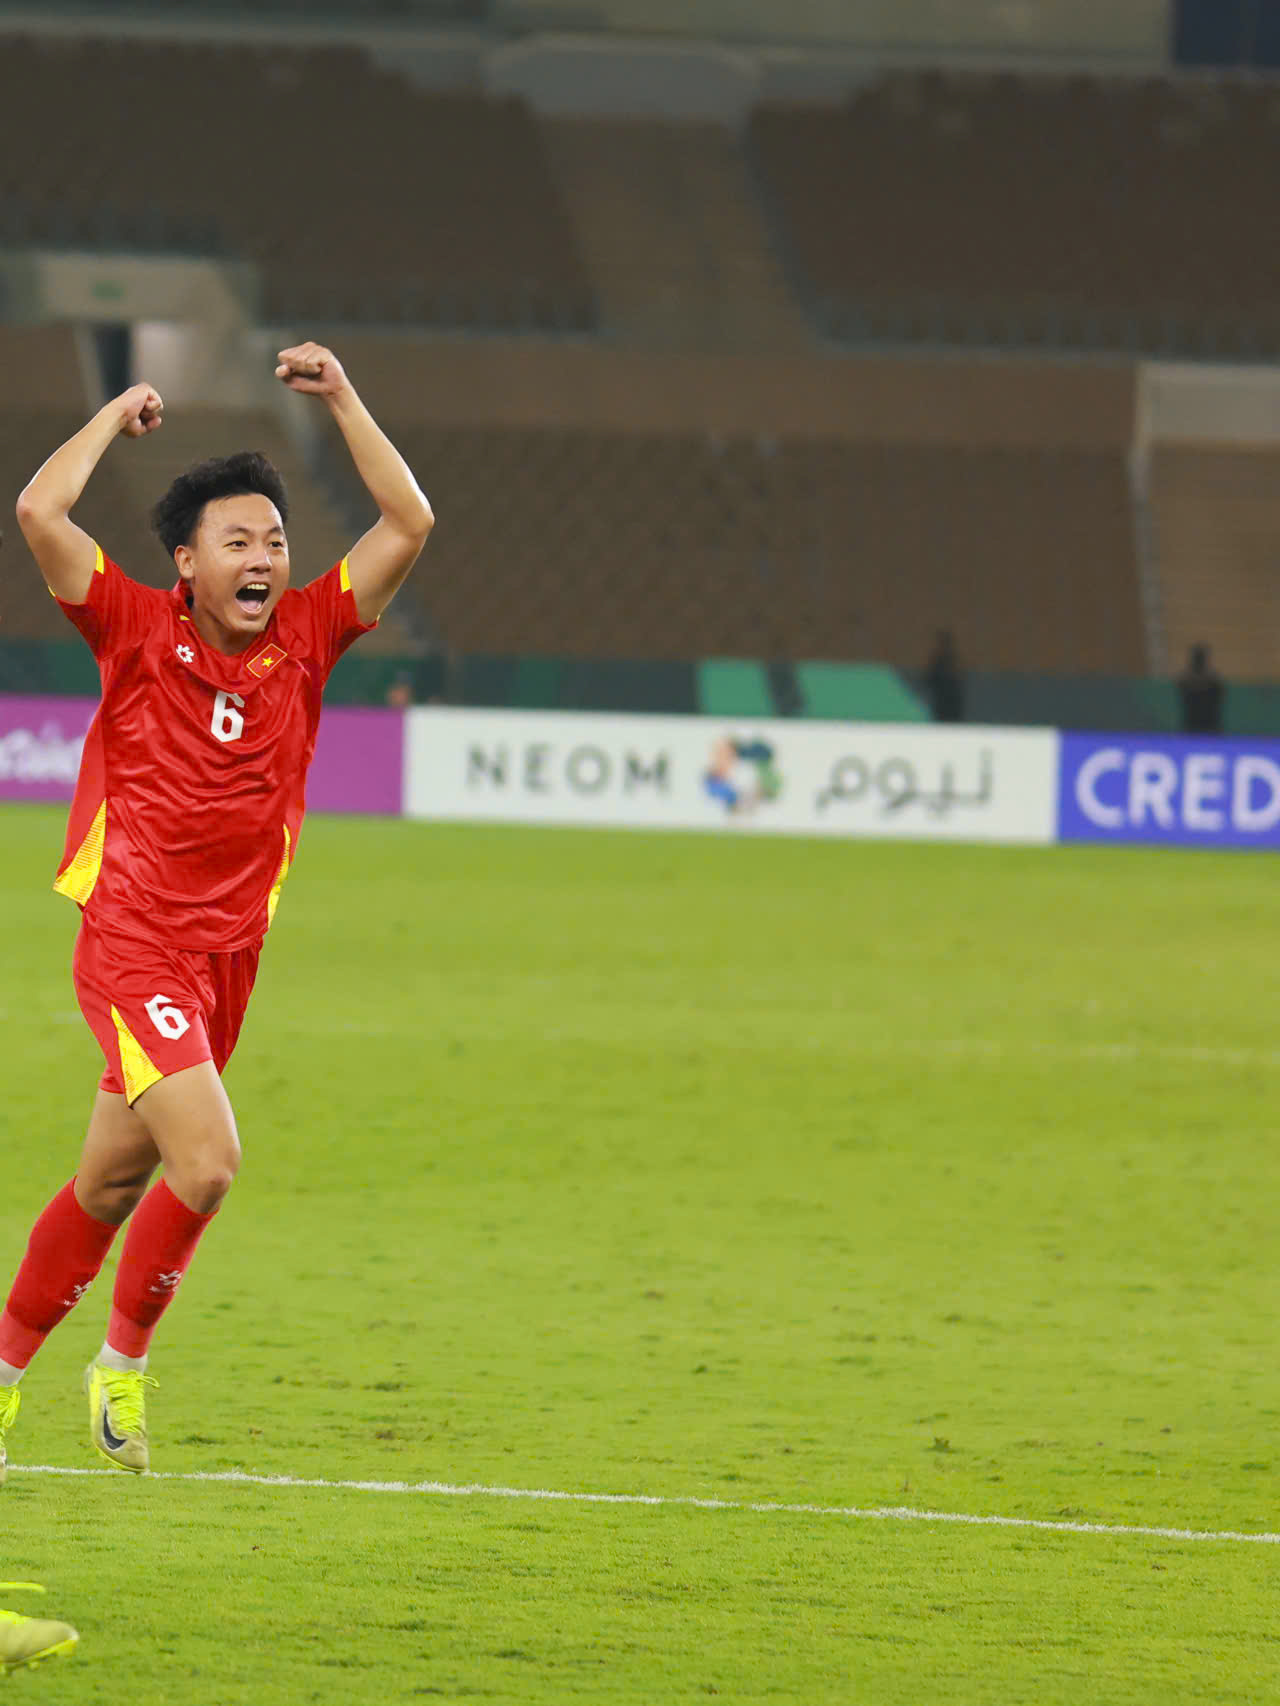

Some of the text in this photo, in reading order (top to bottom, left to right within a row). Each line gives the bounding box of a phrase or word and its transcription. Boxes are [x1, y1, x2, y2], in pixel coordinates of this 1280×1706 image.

[210, 690, 245, 742] 6
[465, 740, 670, 797] NEOM
[1076, 747, 1280, 832] CRED
[143, 993, 191, 1041] 6
